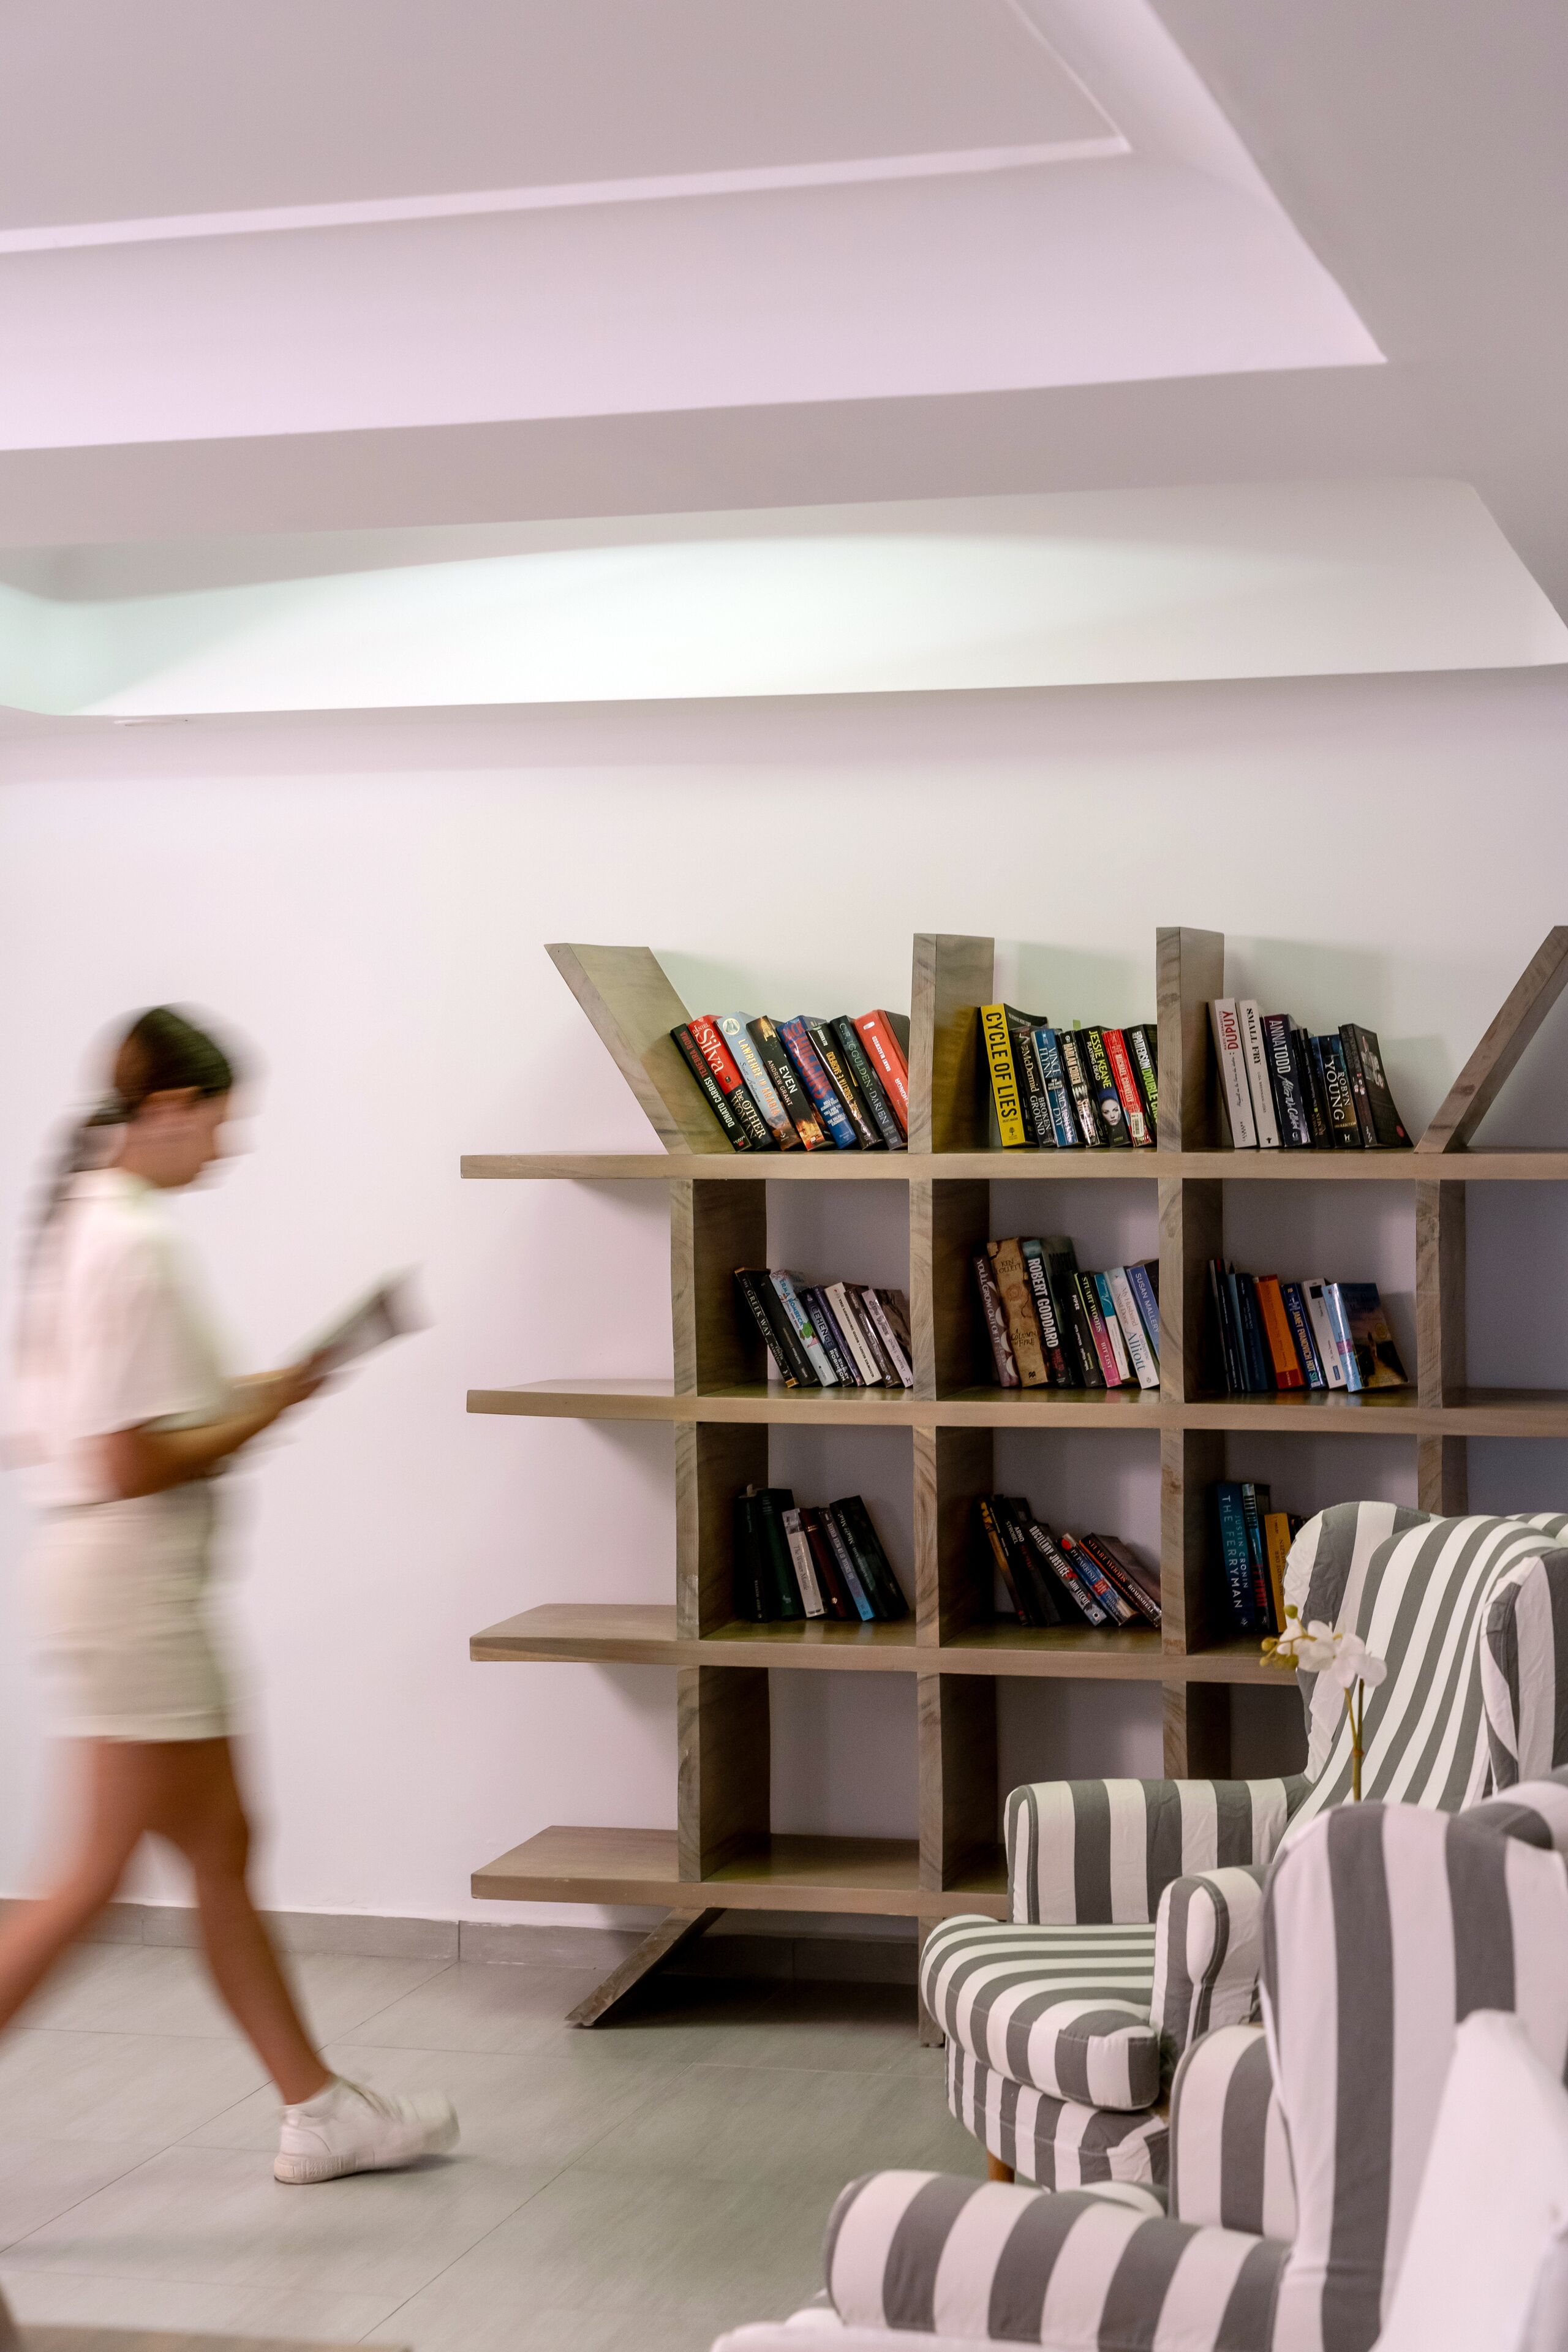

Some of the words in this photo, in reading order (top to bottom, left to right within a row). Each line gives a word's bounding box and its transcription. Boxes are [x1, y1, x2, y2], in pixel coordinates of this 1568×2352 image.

[679, 1030, 694, 1050] ROMA
[986, 1012, 1009, 1060] CYCLE
[1223, 1011, 1238, 1050] DUPUY
[1246, 1008, 1257, 1043] SMALL
[1252, 1046, 1261, 1065] FRY
[1268, 1020, 1284, 1046] ANNA
[688, 1049, 708, 1077] TENEBRA
[696, 1027, 725, 1074] Silva
[826, 1051, 842, 1076] SACRIFICIO
[1039, 1047, 1052, 1078] FLYNN
[1049, 1047, 1060, 1075] VINCE
[1064, 1042, 1077, 1064] HARLAN
[1087, 1042, 1096, 1065] PLAYING
[1092, 1065, 1101, 1080] DEAD
[1089, 1030, 1103, 1058] JESSIE
[1097, 1058, 1112, 1088] KEANE
[1115, 1054, 1127, 1077] MICHAEL
[1273, 1046, 1291, 1073] TODD
[738, 1039, 760, 1079] LAWRENCE
[761, 1085, 778, 1116] ARABIA
[767, 1060, 783, 1087] ANDREW
[777, 1086, 793, 1106] GRANT
[778, 1065, 797, 1094] EVEN
[788, 1036, 833, 1099] HIGGINS
[848, 1041, 872, 1088] IGGULDEN
[869, 1089, 889, 1124] DARIEN
[993, 1063, 1012, 1082] OF
[1023, 1051, 1039, 1092] McDermid
[1069, 1065, 1081, 1084] COBEN
[1133, 1034, 1151, 1069] PATTERSON
[1142, 1068, 1158, 1101] DOUBLE
[703, 1076, 722, 1103] CARRISI
[837, 1078, 854, 1101] VENDETTA
[895, 1079, 908, 1101] HONOR
[998, 1085, 1017, 1118] LIES
[1325, 1060, 1344, 1120] YOUNG
[1338, 1072, 1351, 1106] ROBYN
[717, 1102, 734, 1128] DONATO
[733, 1096, 757, 1139] WOMAN
[735, 1089, 744, 1102] the
[742, 1100, 768, 1139] OTHER
[1030, 1096, 1045, 1136] GROUND
[1038, 1097, 1052, 1131] BROKEN
[1053, 1107, 1063, 1126] DAY
[779, 1280, 789, 1297] ERMA
[1028, 1258, 1047, 1296] ROBERT
[1038, 1298, 1059, 1348] GODDARD
[1080, 1276, 1093, 1304] STUART
[1089, 1304, 1102, 1332] WOODS
[1134, 1272, 1148, 1298] SUSAN
[1144, 1299, 1159, 1333] MALLERY
[747, 1290, 763, 1320] GREEK
[761, 1319, 771, 1336] WAY
[842, 1305, 854, 1330] LONESOME
[982, 1284, 992, 1308] GROW
[990, 1325, 998, 1335] OF
[1119, 1306, 1129, 1325] Door
[1123, 1297, 1138, 1327] Husband
[1291, 1310, 1303, 1329] JANET
[1019, 1338, 1035, 1347] FIRE
[1126, 1329, 1146, 1371] Alliott
[1296, 1328, 1312, 1360] EVANOVICH
[829, 1350, 846, 1381] ROBINSON
[837, 1357, 850, 1379] STANLEY
[1305, 1359, 1315, 1373] HOT
[1308, 1371, 1317, 1382] SIX
[1222, 1494, 1233, 1523] THE
[1006, 1509, 1017, 1544] STROBEL
[1014, 1526, 1025, 1542] ARNO
[1235, 1515, 1245, 1547] JUSTIN
[1028, 1525, 1054, 1556] ANCILLARY
[1048, 1552, 1070, 1577] JUSTICE
[1068, 1578, 1080, 1592] ANN
[1076, 1589, 1090, 1606] LECKIE
[1075, 1556, 1097, 1582] PARRISH
[1087, 1538, 1108, 1561] STUART
[1105, 1559, 1128, 1583] WOODS
[1127, 1583, 1155, 1614] BOMBSHELL
[1226, 1531, 1243, 1608] FERRYMAN
[1238, 1552, 1248, 1588] CRONIN
